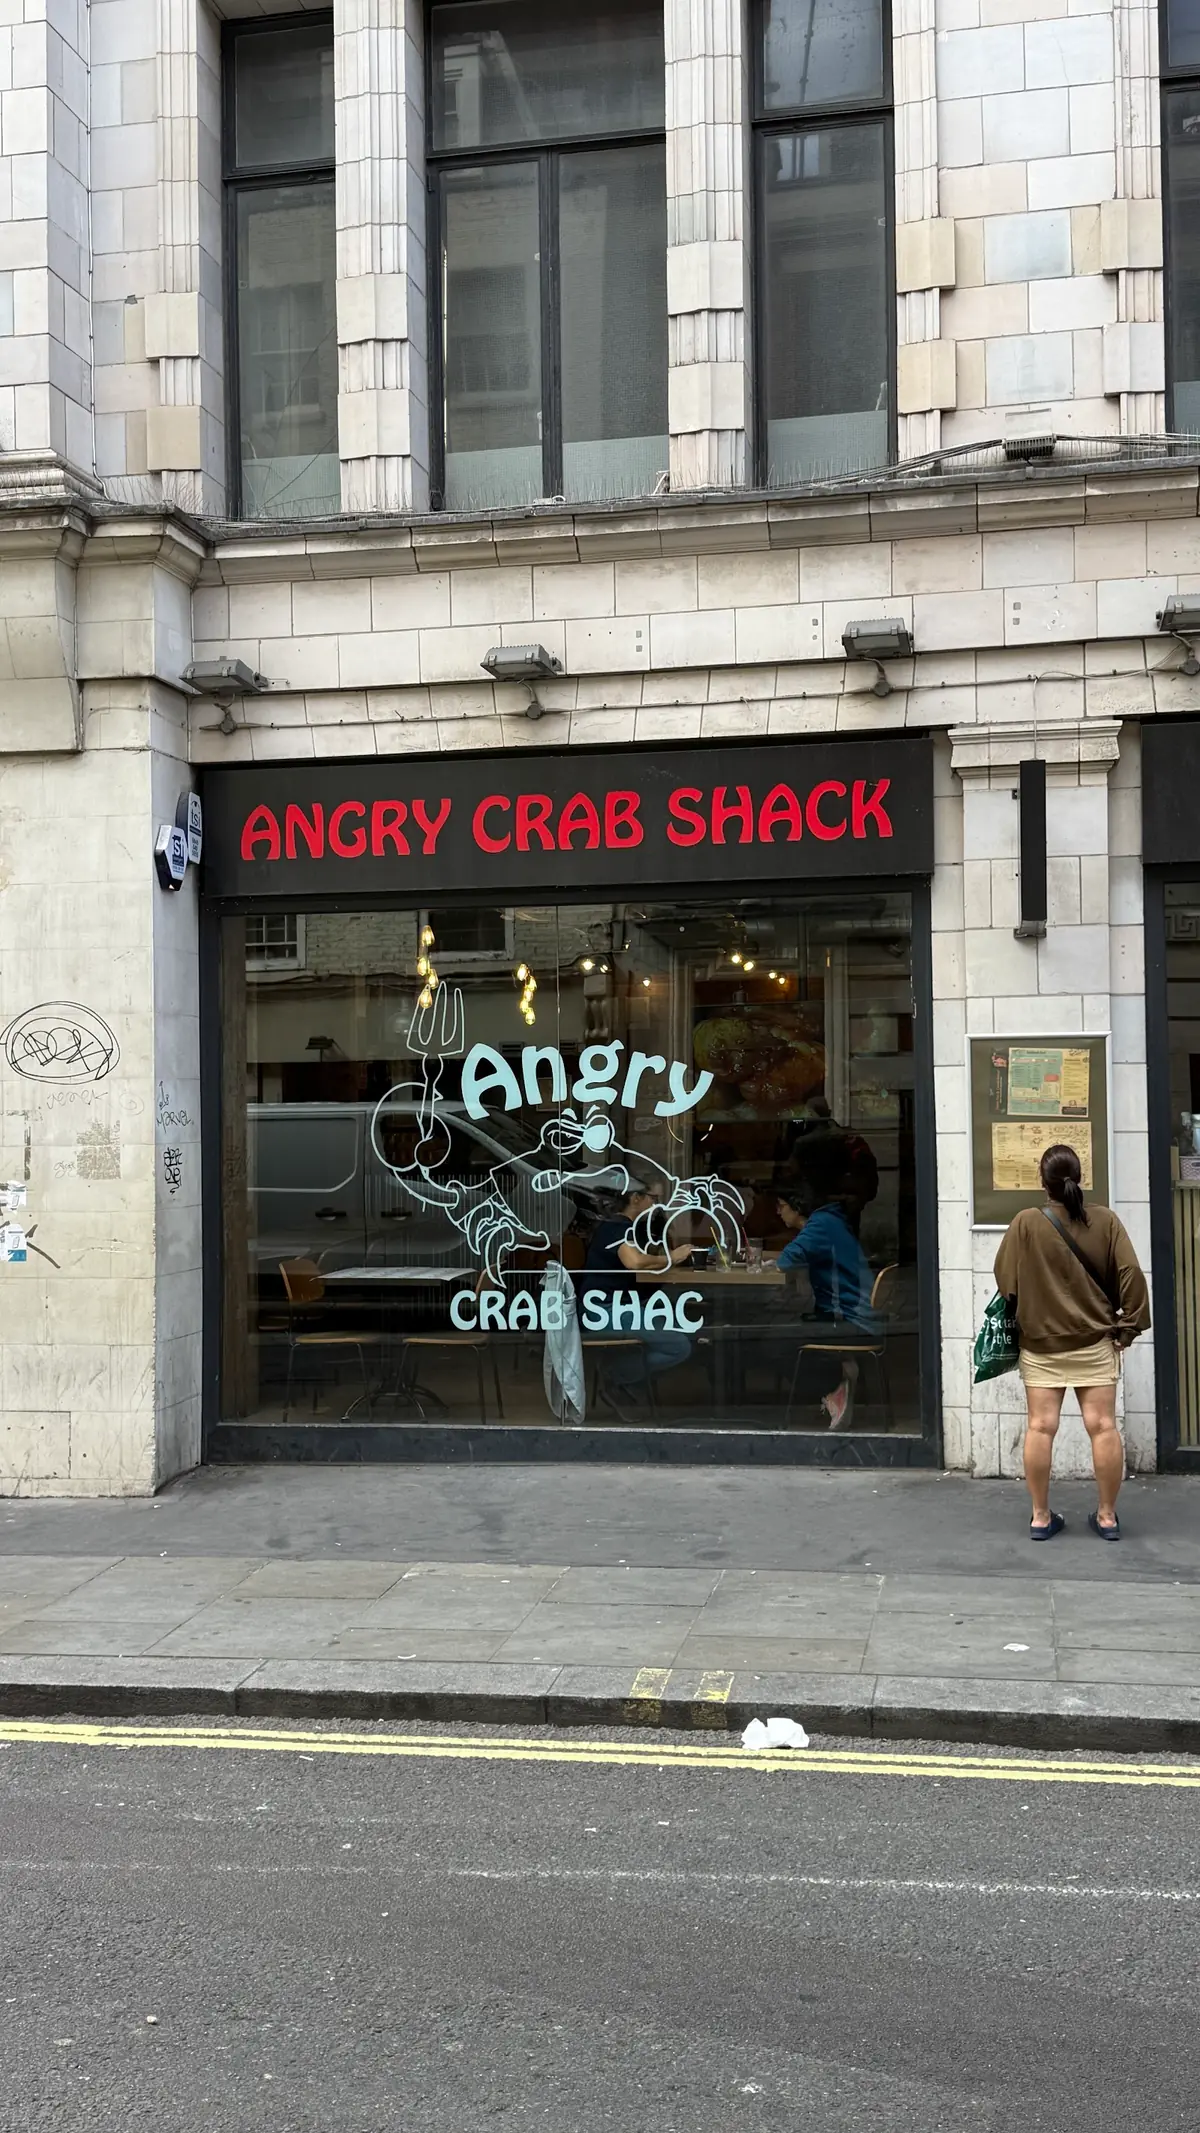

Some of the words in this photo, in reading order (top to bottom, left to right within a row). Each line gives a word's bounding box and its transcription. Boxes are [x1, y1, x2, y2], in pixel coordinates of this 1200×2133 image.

[240, 797, 452, 861] ANGRY
[472, 790, 645, 854] CRAB
[666, 778, 893, 847] SHACK
[461, 1039, 714, 1120] Angry
[450, 1290, 568, 1331] CRAB
[582, 1289, 704, 1333] SHAC
